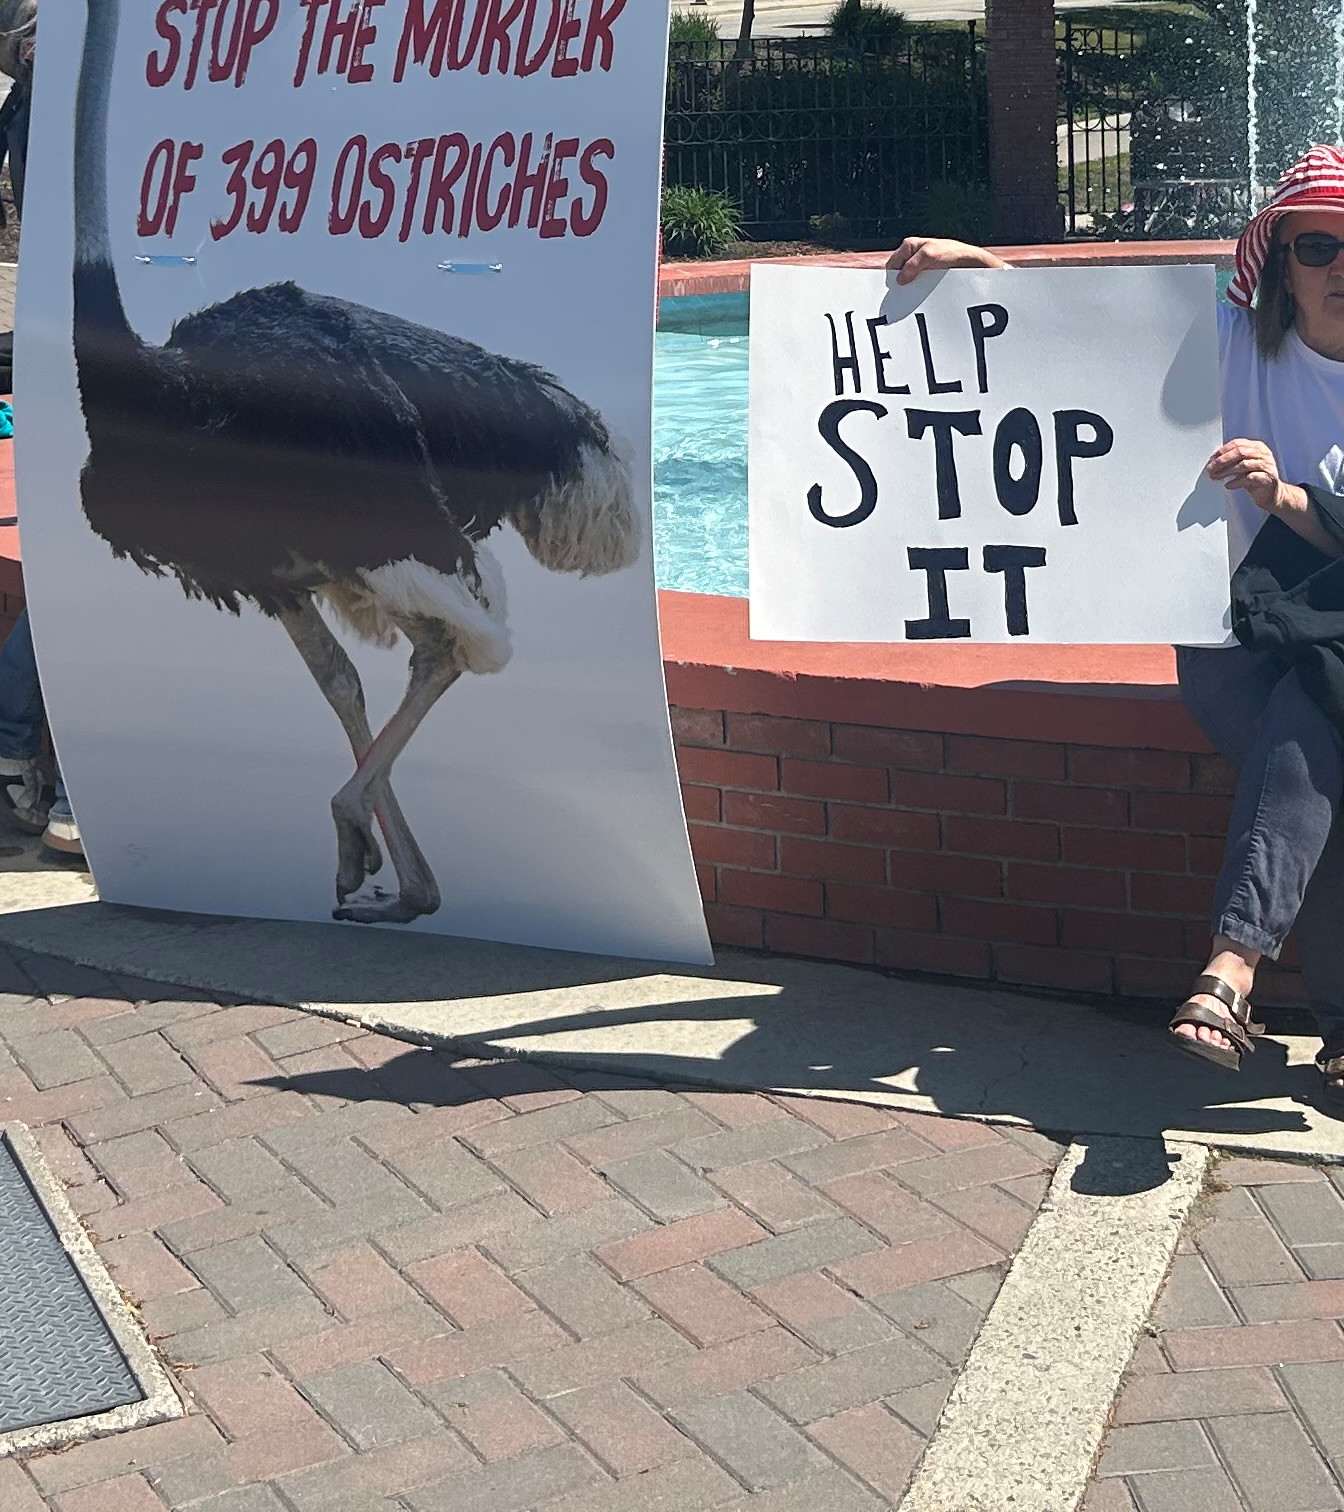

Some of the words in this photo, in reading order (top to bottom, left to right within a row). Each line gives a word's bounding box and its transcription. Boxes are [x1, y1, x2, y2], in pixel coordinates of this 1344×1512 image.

[137, 137, 204, 239] OF
[209, 136, 317, 242] 399
[328, 131, 615, 242] OSTRICHES
[824, 303, 1009, 396] HELP
[807, 399, 1114, 528] STOP
[904, 545, 1047, 639] IT
